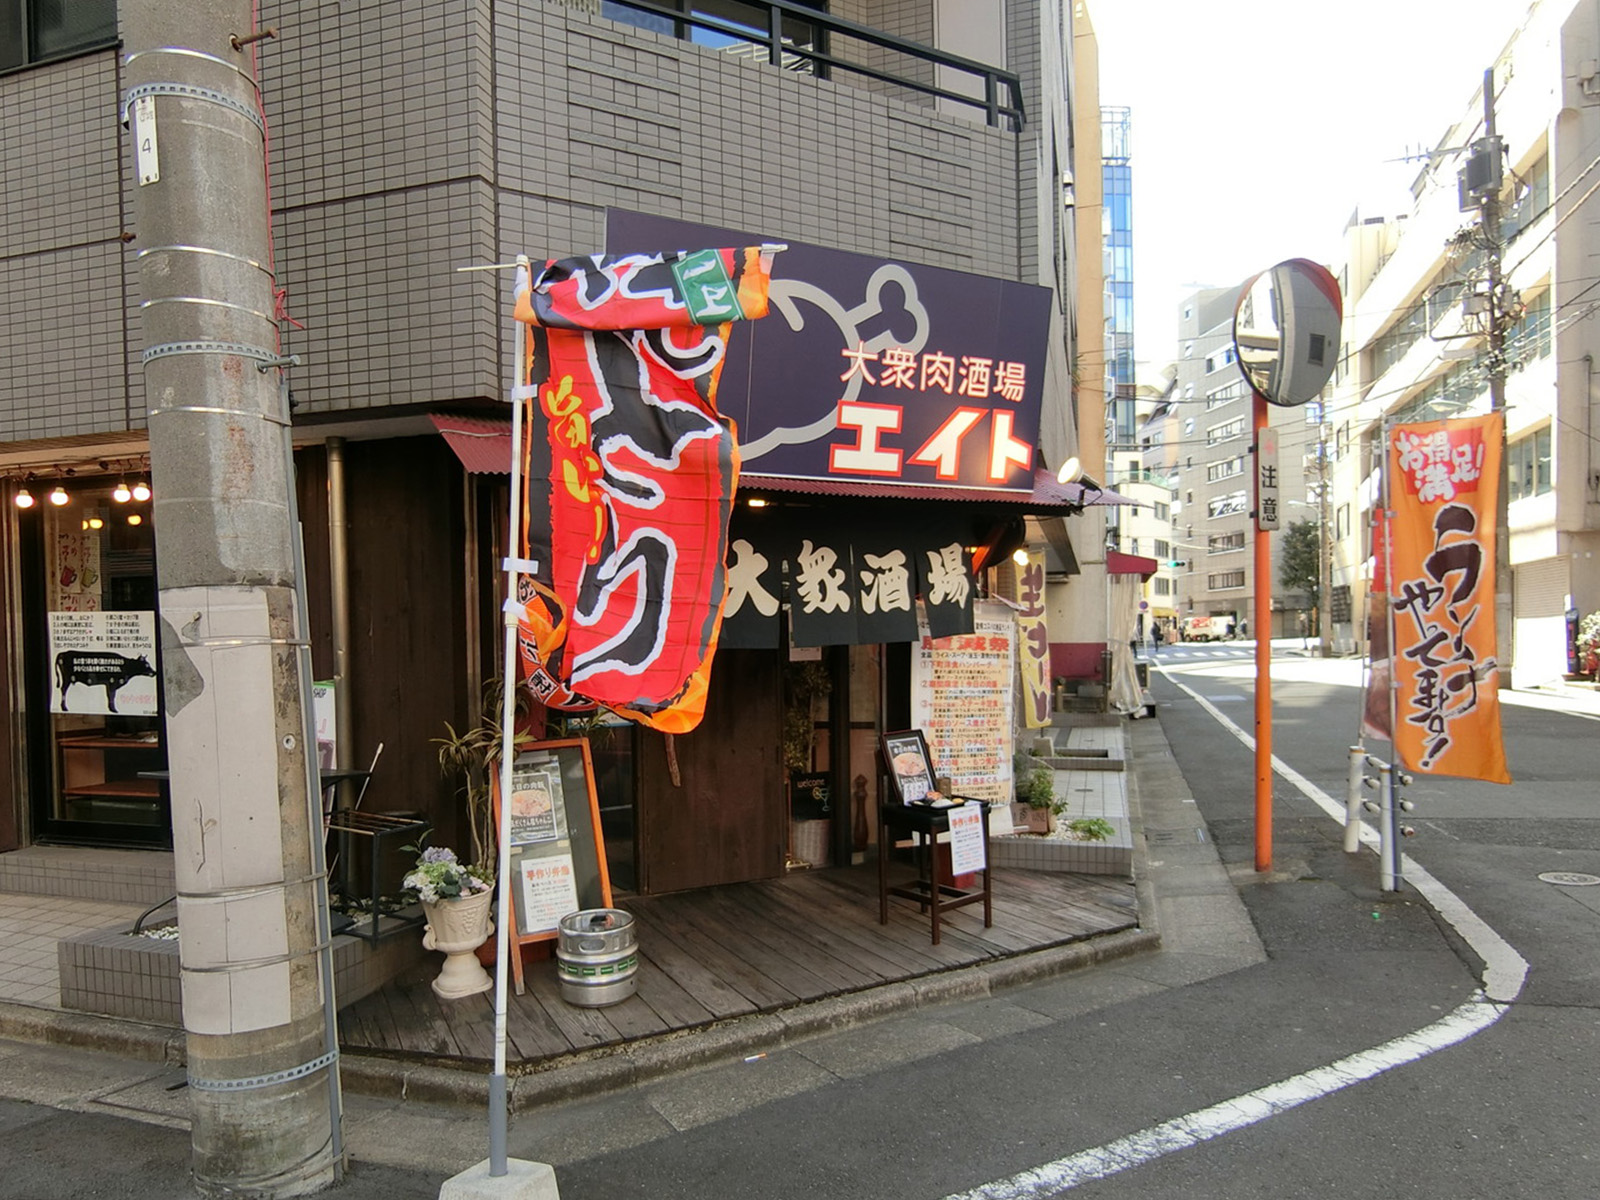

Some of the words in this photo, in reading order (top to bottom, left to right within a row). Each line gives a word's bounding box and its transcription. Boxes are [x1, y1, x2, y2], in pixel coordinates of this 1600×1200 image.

[141, 137, 152, 154] 4
[840, 339, 1026, 402] 大衆肉酒場
[828, 399, 1033, 484] エイト
[1394, 430, 1484, 502] お得満足!
[1261, 465, 1278, 522] 注意
[725, 538, 971, 619] 大衆酒場
[1426, 504, 1499, 718] ランチ
